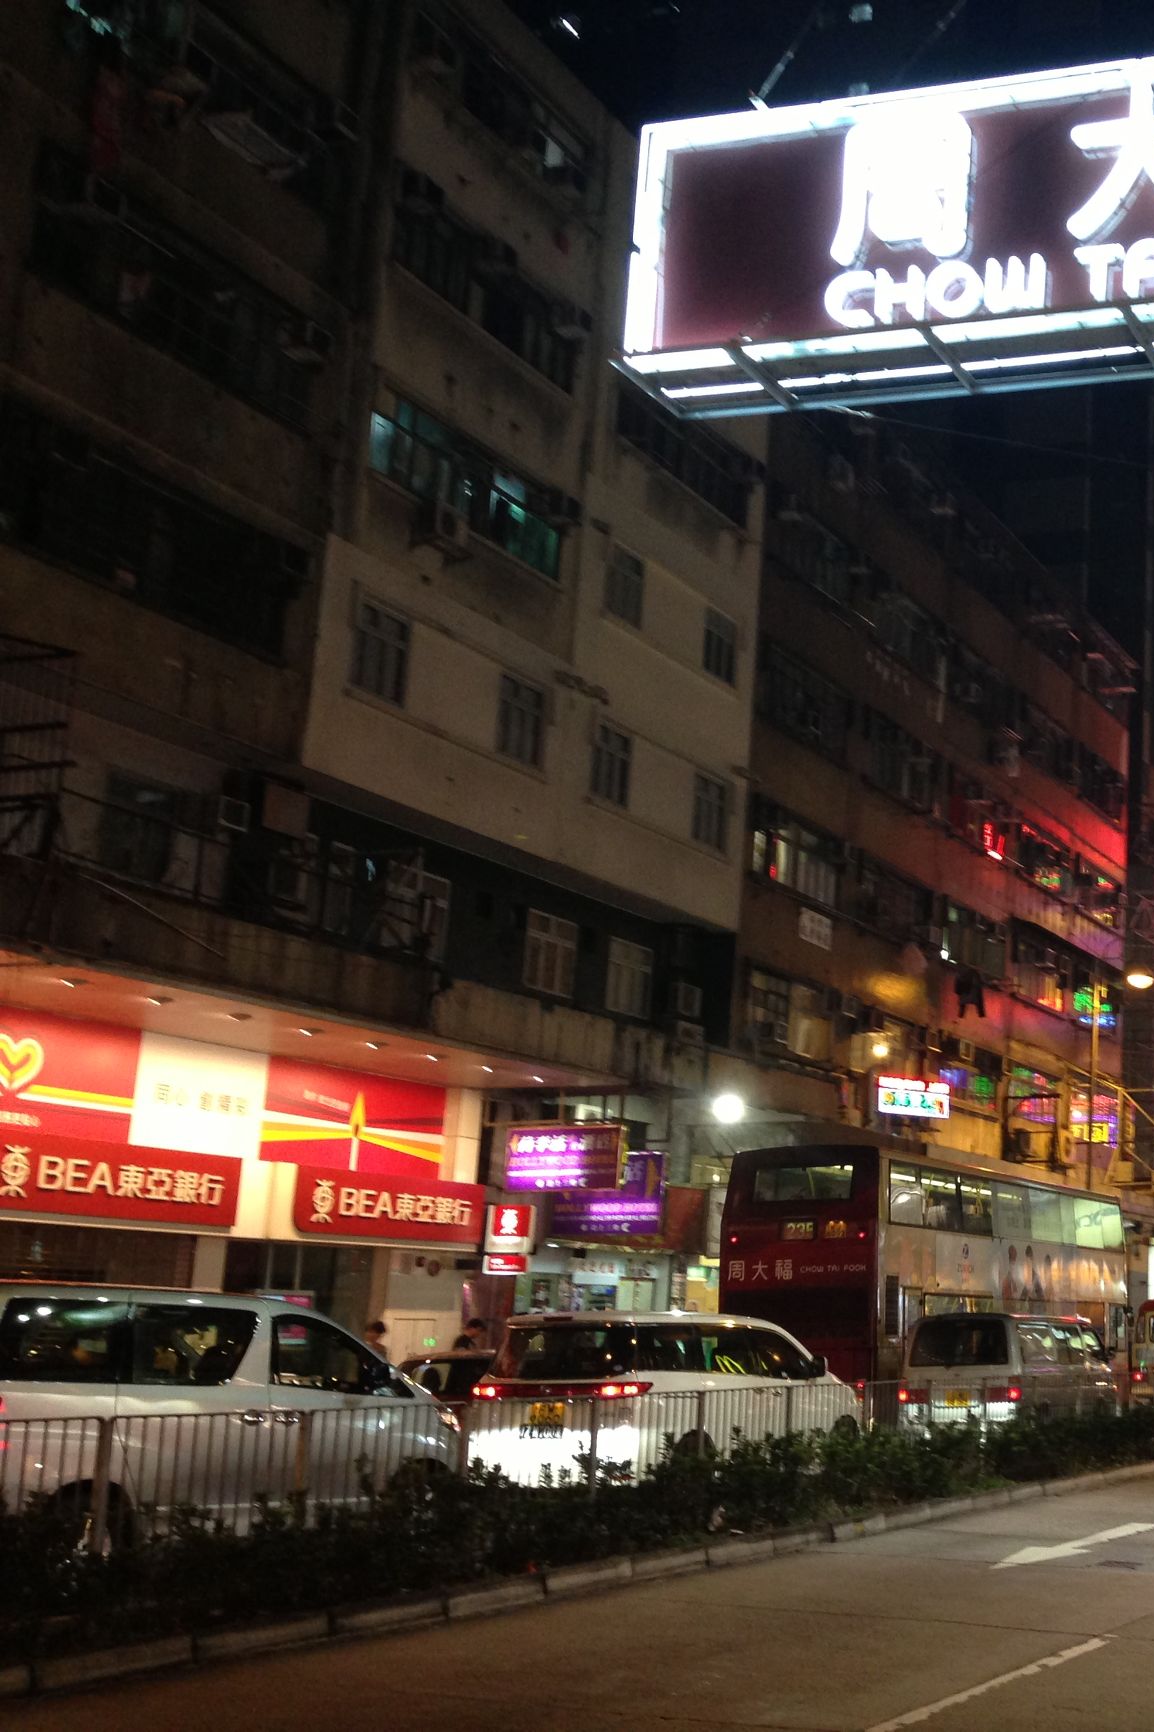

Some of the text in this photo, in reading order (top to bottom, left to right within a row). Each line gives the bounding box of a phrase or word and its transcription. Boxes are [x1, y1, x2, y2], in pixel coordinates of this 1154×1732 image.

[823, 250, 1046, 329] CHOW
[36, 1154, 226, 1208] BEA 東亞銀行
[338, 1186, 473, 1228] BEA 東亞銀行
[726, 1258, 794, 1282] 周大福
[799, 1264, 824, 1275] CHOW
